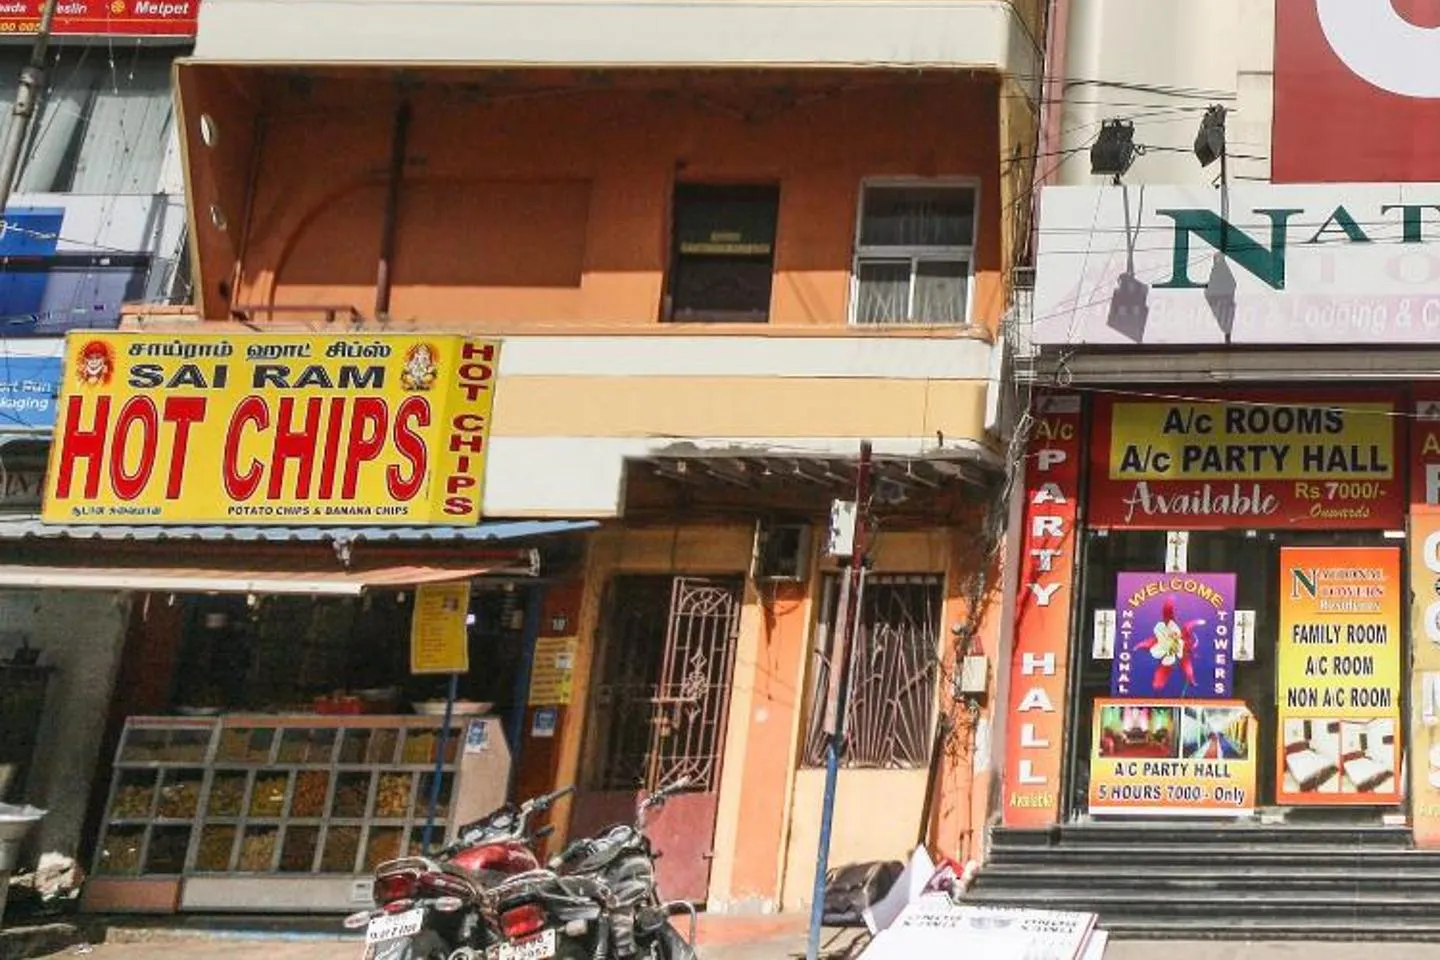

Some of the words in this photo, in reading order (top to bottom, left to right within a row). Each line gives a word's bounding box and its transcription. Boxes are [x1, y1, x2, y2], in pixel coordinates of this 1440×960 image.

[1291, 297, 1388, 334] Lodging
[1396, 298, 1413, 327] &
[128, 364, 228, 389] SAI
[252, 364, 386, 389] RAM
[459, 342, 495, 402] HOT
[1035, 419, 1074, 440] A/c
[1163, 409, 1212, 435] A/c
[1226, 407, 1344, 435] ROOMS
[55, 395, 208, 501] HOT
[223, 395, 432, 502] CHIPS
[1120, 445, 1171, 473] A/c
[1182, 445, 1290, 473] PARTY
[1304, 445, 1388, 473] HALL
[442, 414, 485, 517] CHIPS
[228, 506, 274, 516] POTATO
[276, 506, 310, 516] CHIPS
[326, 506, 372, 516] BANANA
[376, 506, 408, 516] CHIPS
[1123, 481, 1281, 523] Available
[1296, 483, 1320, 500] Rs
[1325, 481, 1387, 500] 7000/-
[1309, 504, 1370, 521] Onwards
[1025, 449, 1067, 608] PARTY
[1128, 578, 1224, 608] WELCOME
[1293, 623, 1341, 645] FAMILY
[1346, 623, 1387, 644] ROOM
[1118, 610, 1133, 694] NATIONAL
[1214, 611, 1229, 694] TOWERS
[1333, 655, 1374, 676] ROOM
[1287, 687, 1319, 708] NON
[1351, 686, 1391, 707] ROOM
[1018, 652, 1056, 785] HALL
[1143, 761, 1189, 777] PARTY
[1194, 762, 1231, 778] HALL
[1111, 784, 1161, 800] HOURS
[1215, 786, 1245, 805] Only
